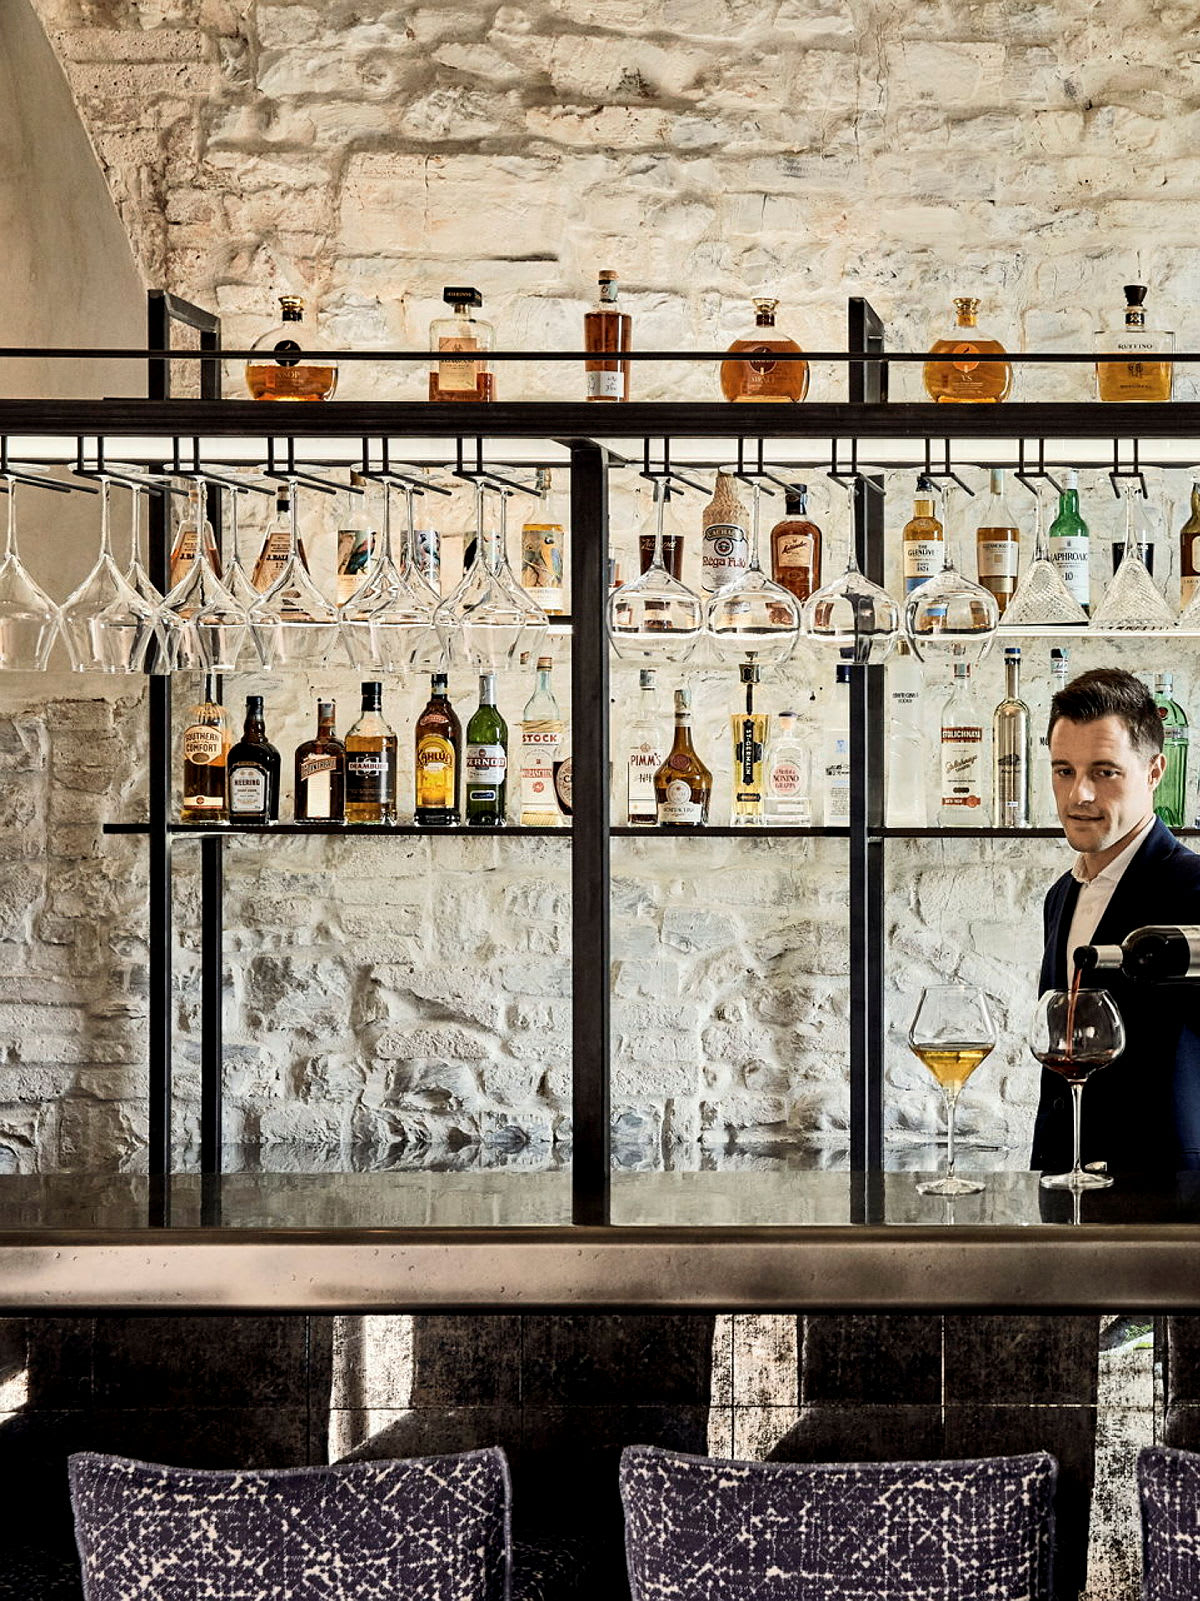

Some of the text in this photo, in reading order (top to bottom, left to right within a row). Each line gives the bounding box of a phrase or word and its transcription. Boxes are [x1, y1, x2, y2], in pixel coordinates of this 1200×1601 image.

[522, 734, 557, 743] STOCK
[185, 744, 217, 753] COMFORT
[631, 752, 662, 766] PIMM'S
